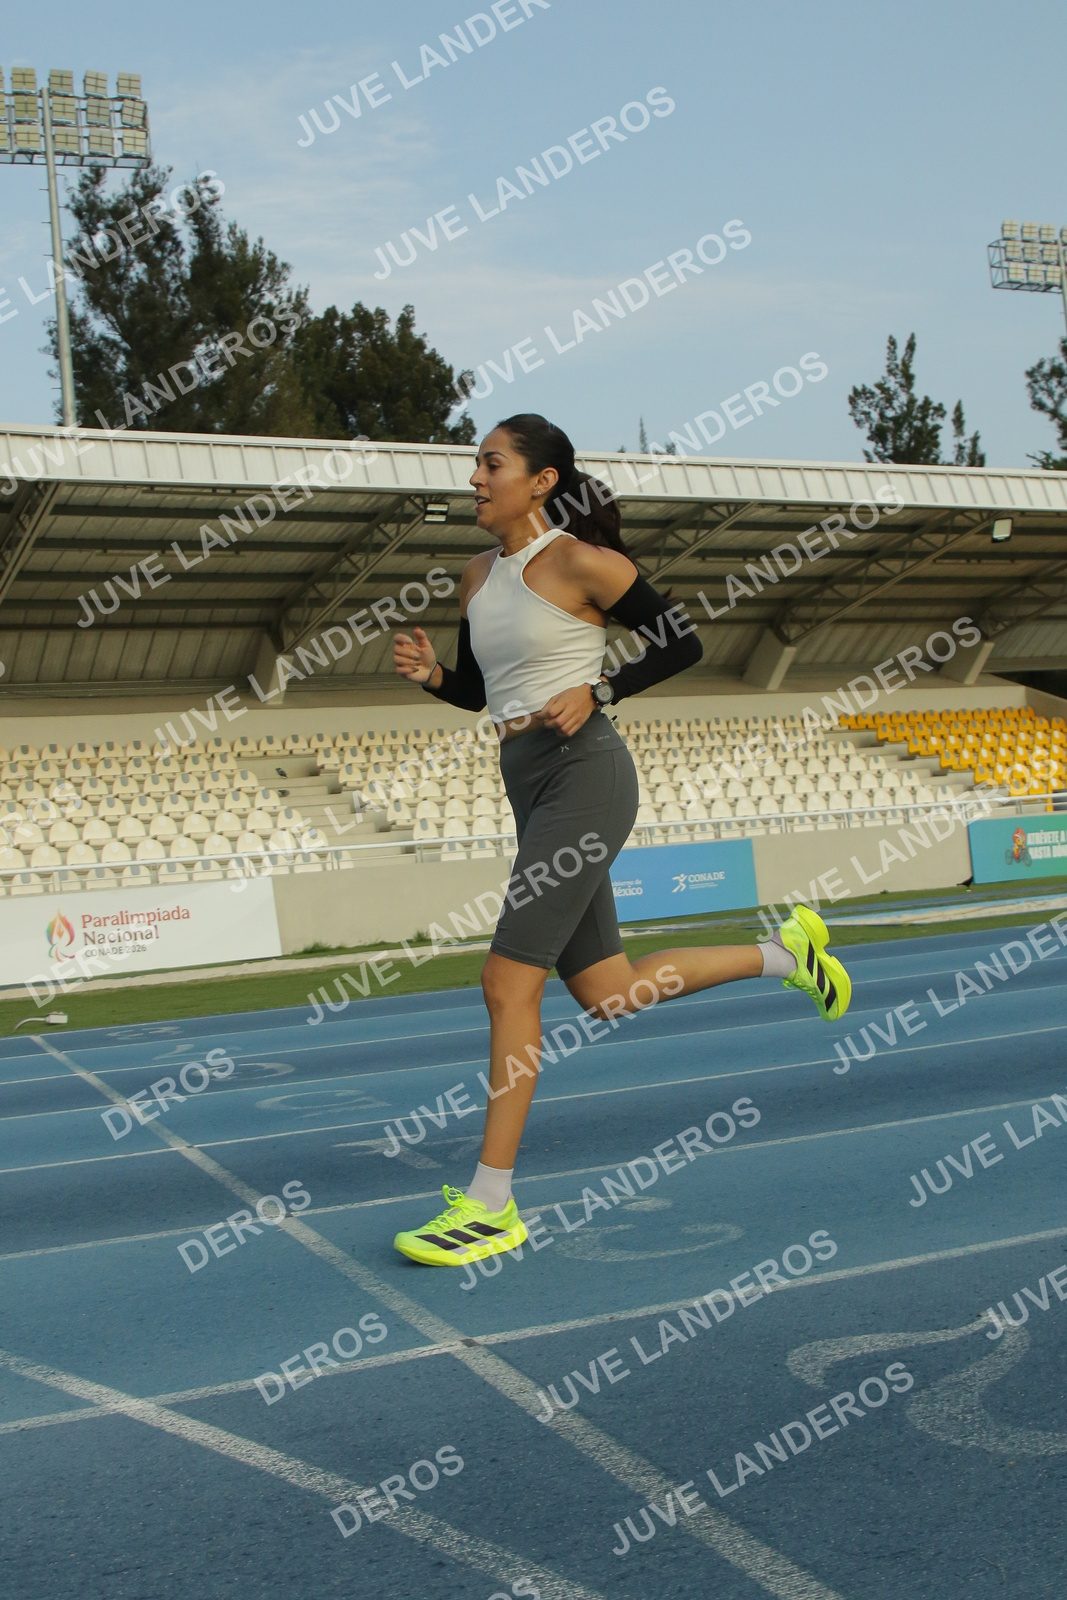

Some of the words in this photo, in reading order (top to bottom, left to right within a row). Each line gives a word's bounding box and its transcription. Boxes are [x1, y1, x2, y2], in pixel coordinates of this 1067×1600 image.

[687, 871, 726, 883] CONADE
[81, 905, 191, 929] Paralimpiada
[83, 924, 160, 946] Nacional
